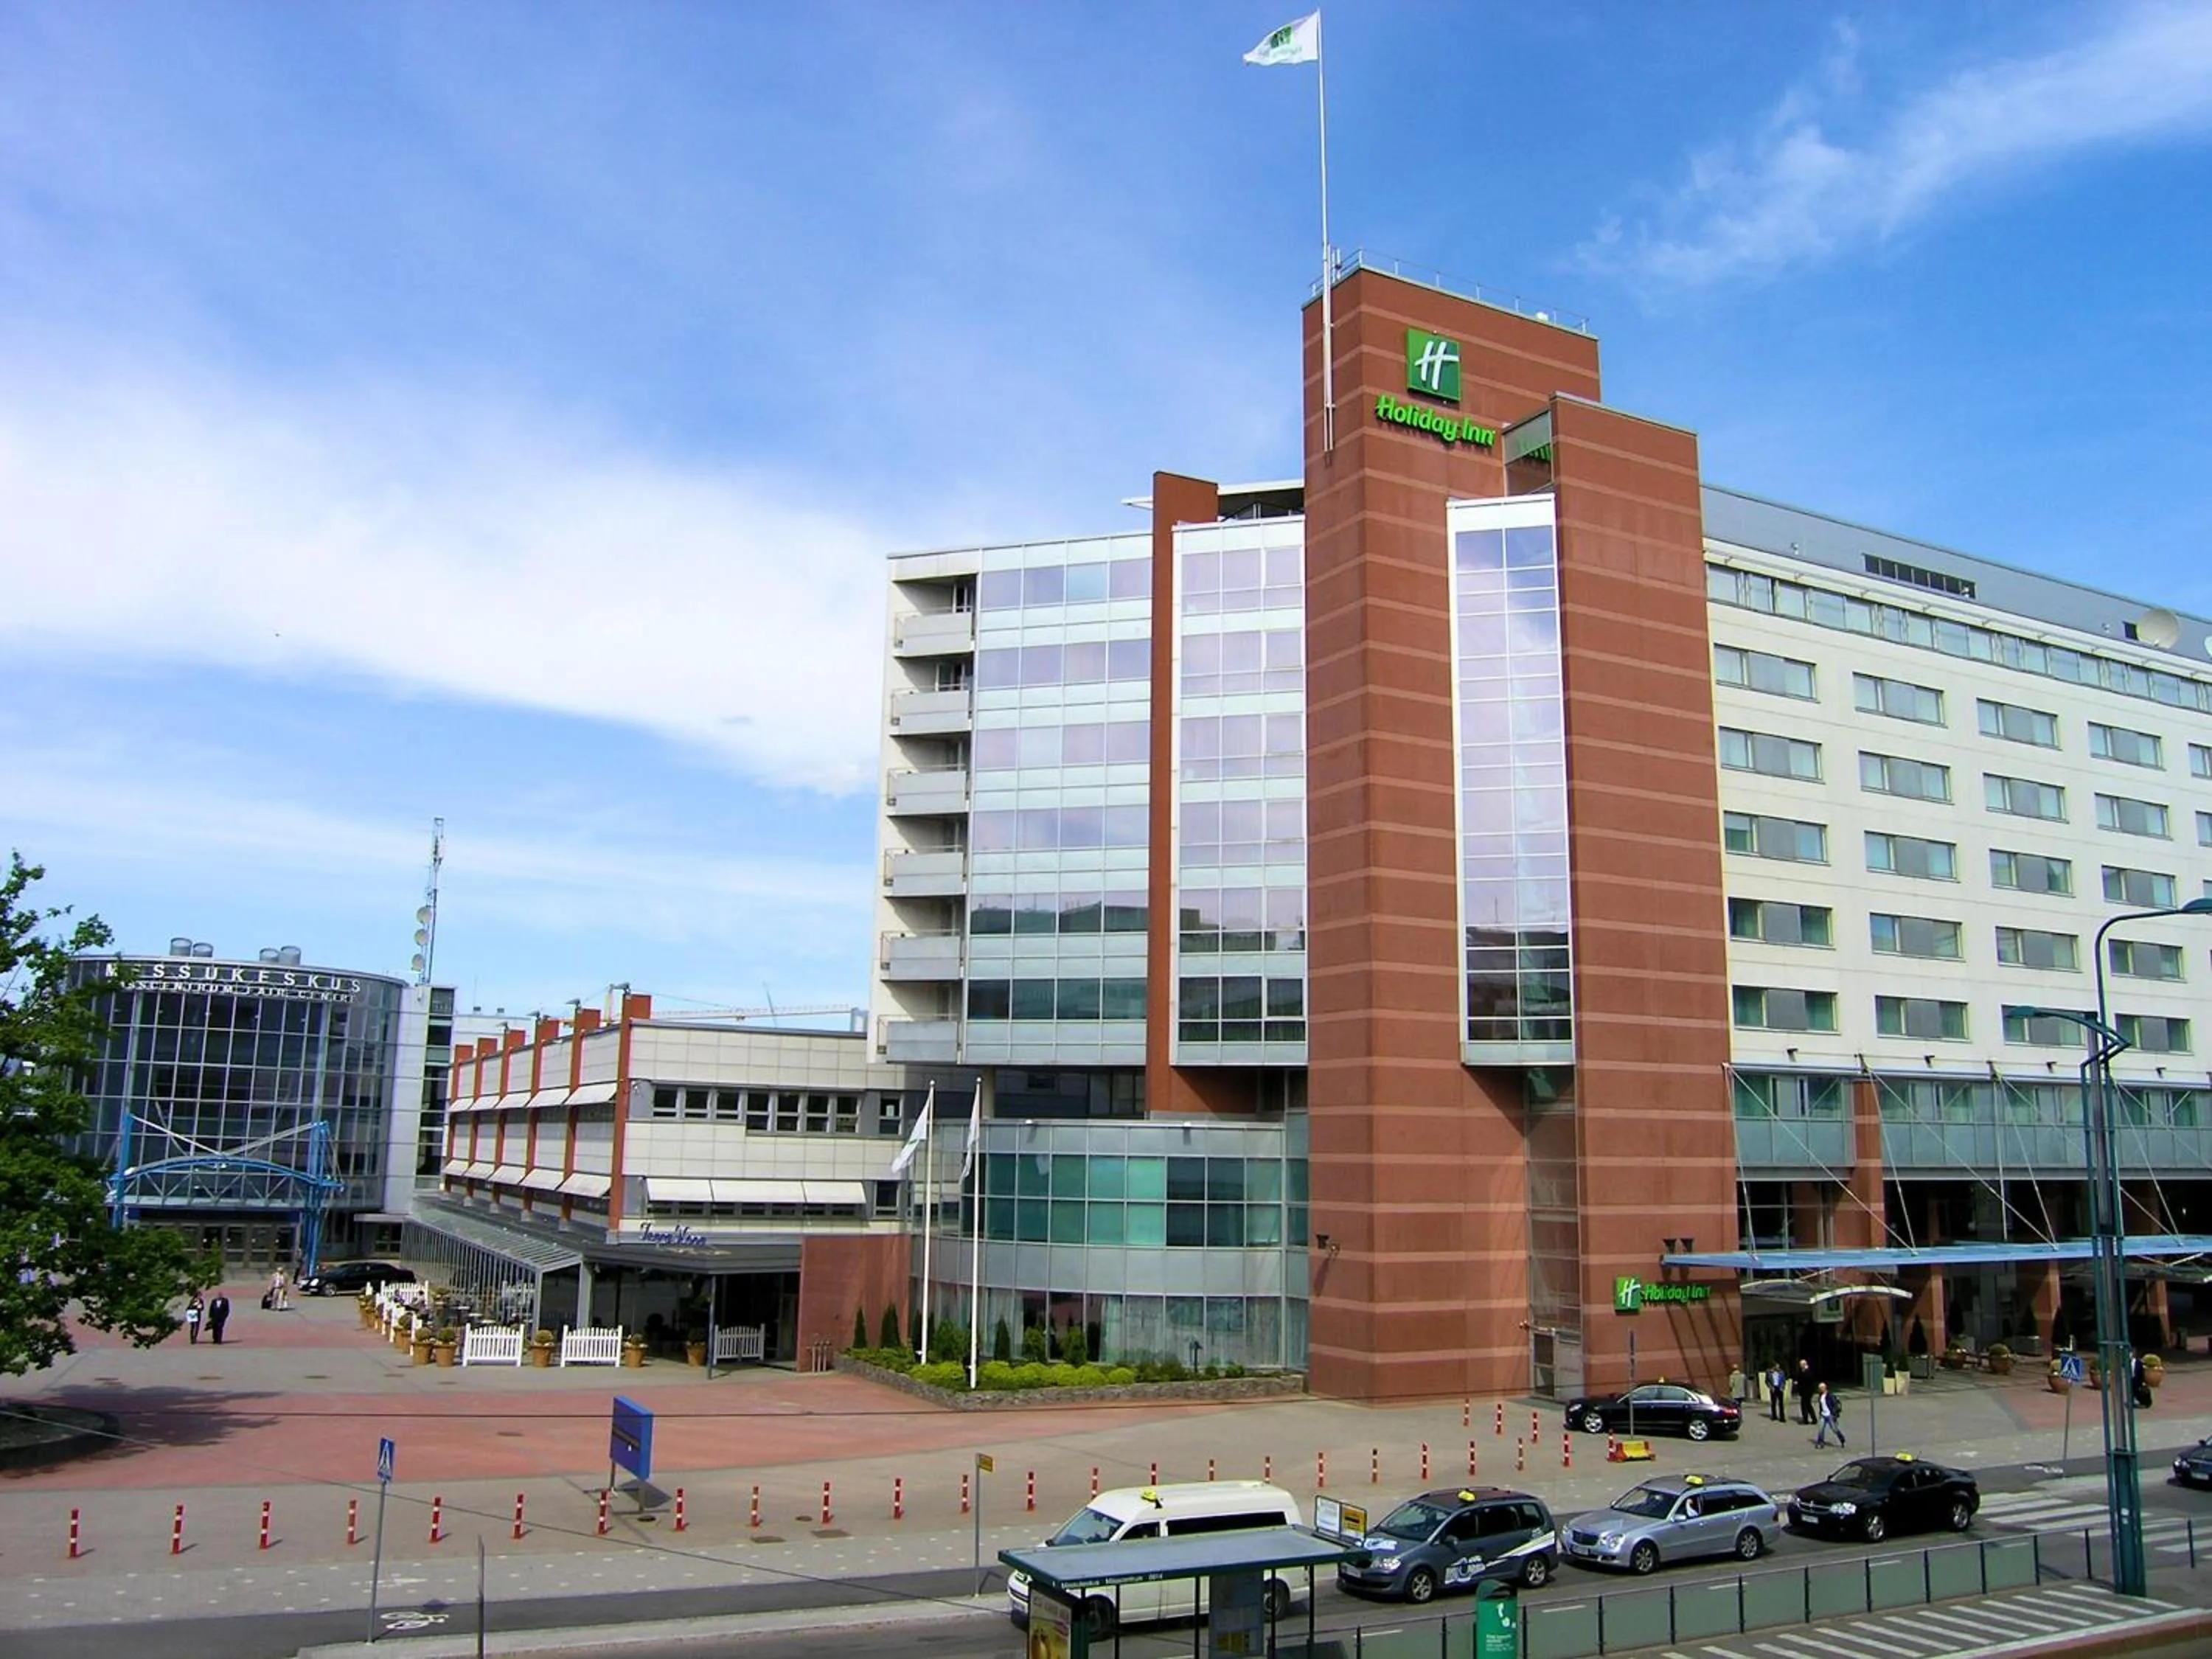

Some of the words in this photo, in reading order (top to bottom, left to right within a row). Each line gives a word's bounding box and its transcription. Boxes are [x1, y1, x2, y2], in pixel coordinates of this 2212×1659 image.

[1376, 394, 1458, 442] Holiday
[1463, 416, 1496, 447] Inn
[108, 979, 234, 994] SSCENTRUM
[1645, 1284, 1691, 1303] Holiday
